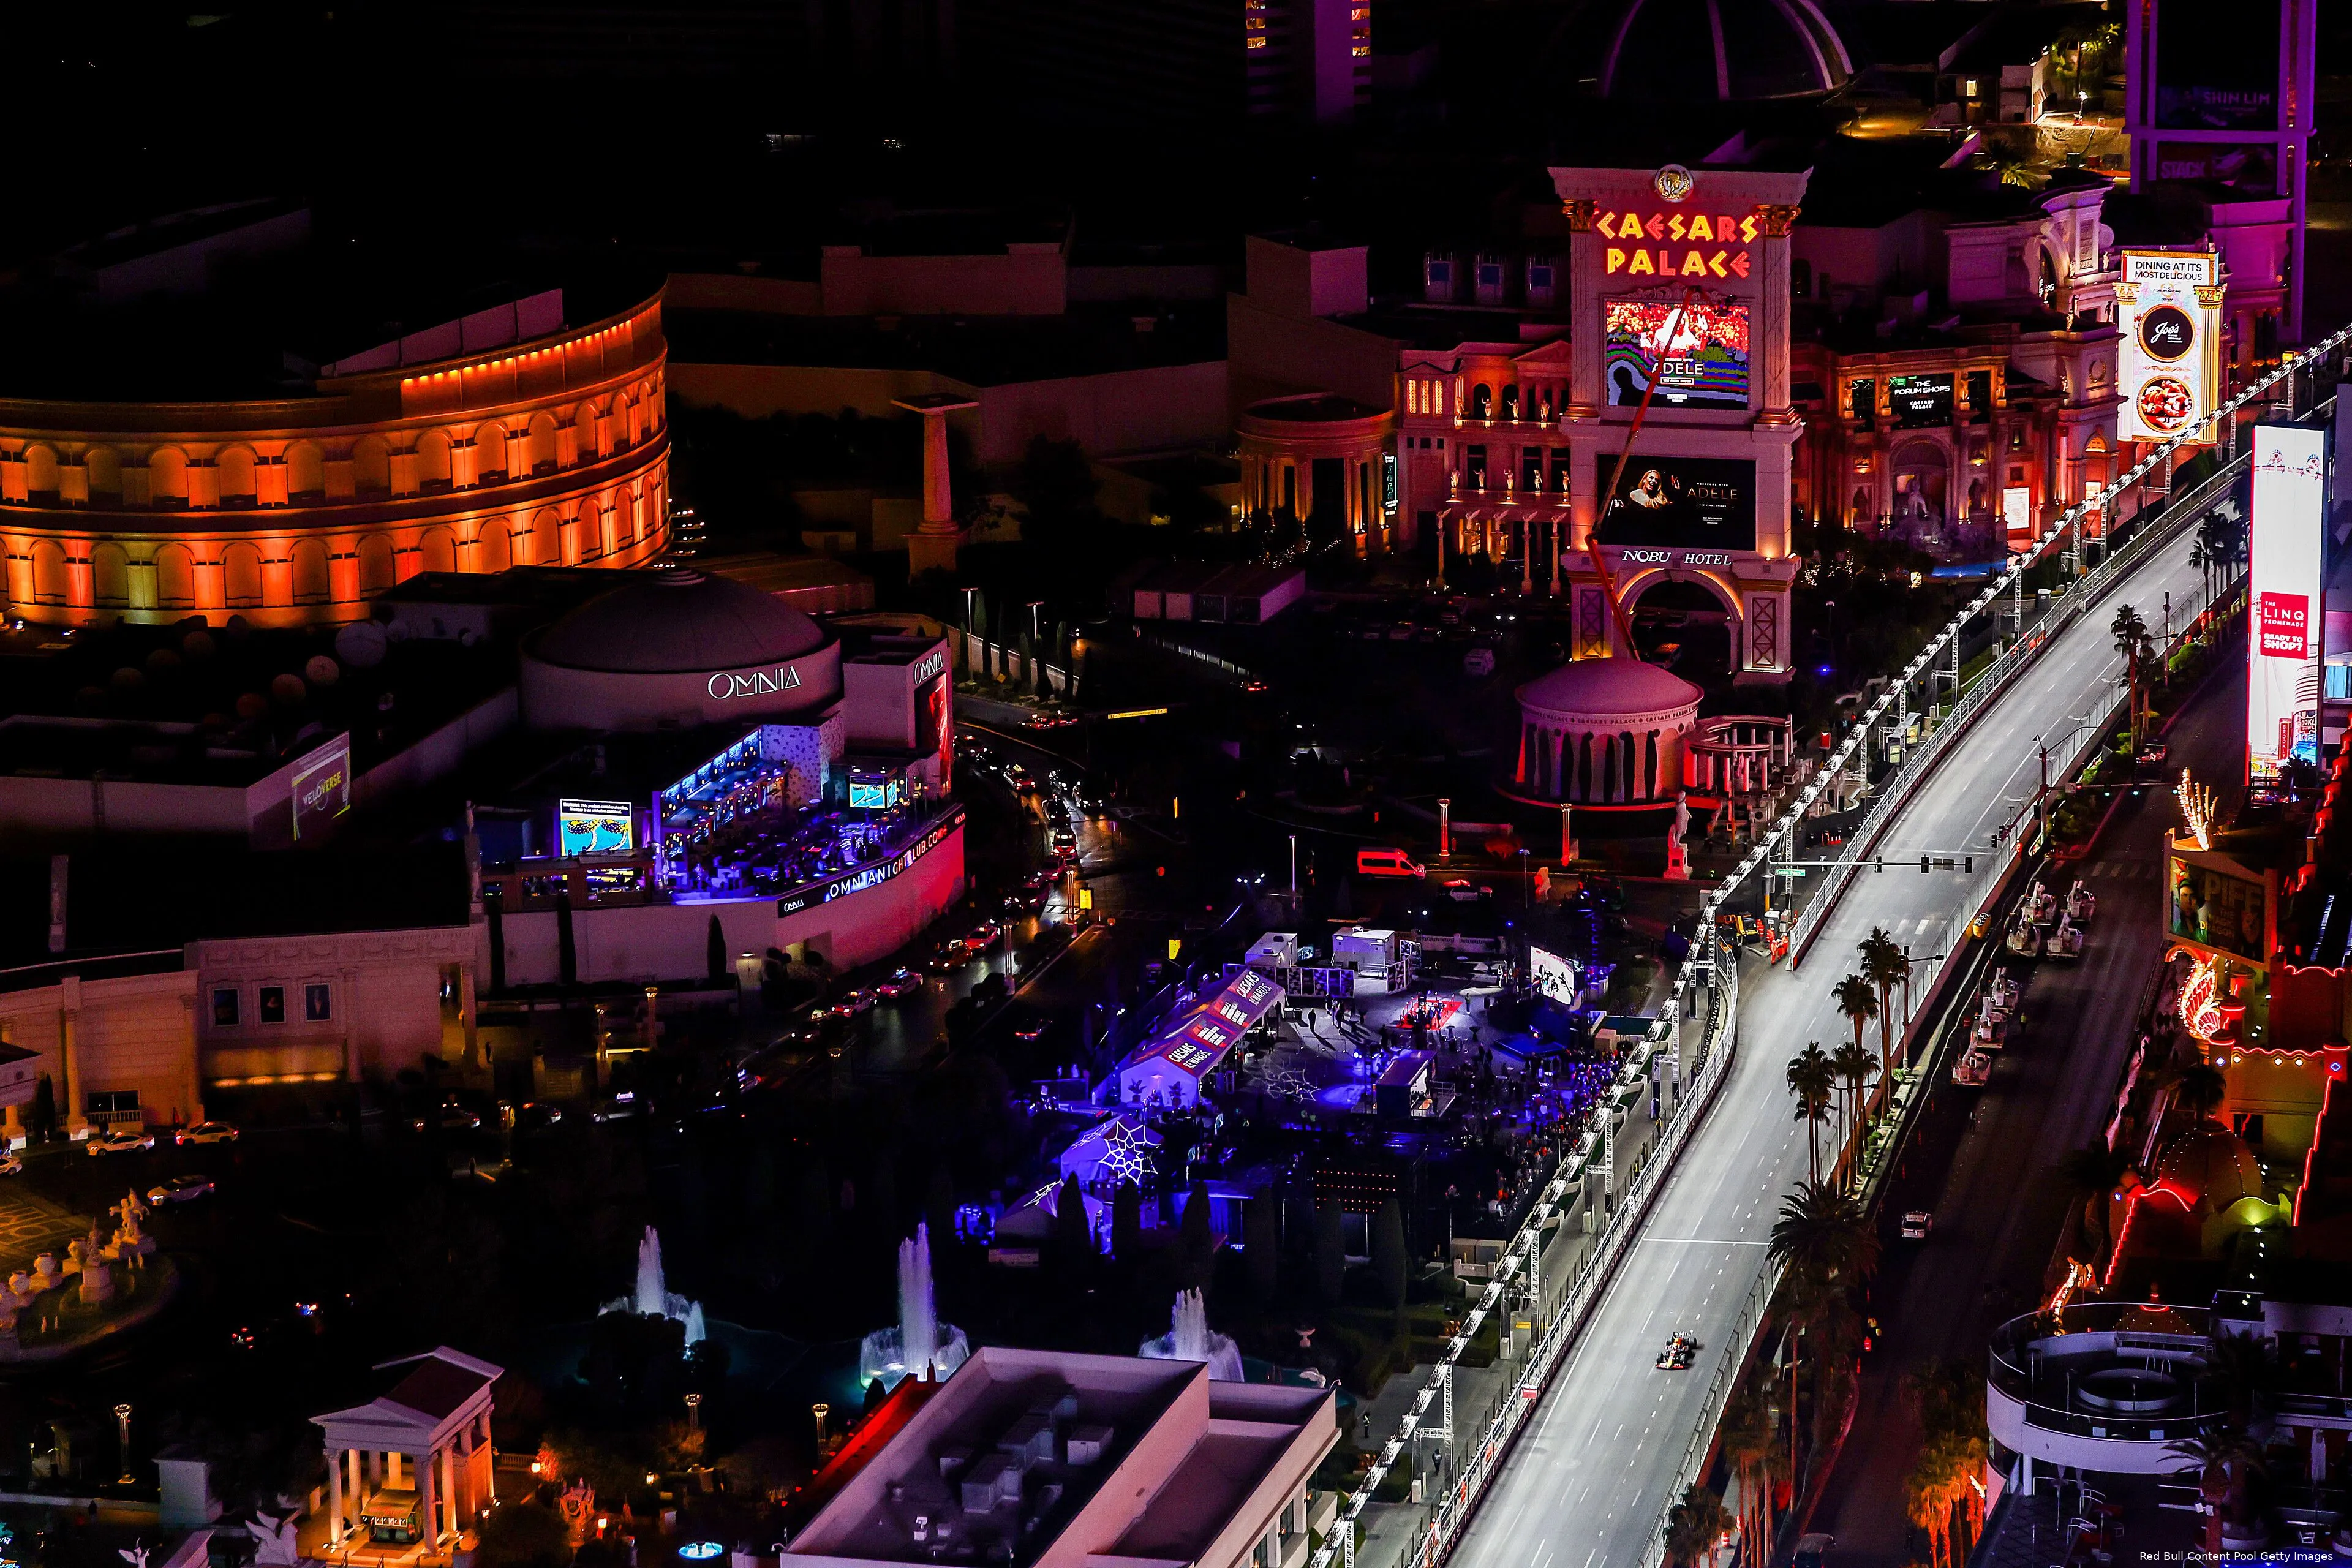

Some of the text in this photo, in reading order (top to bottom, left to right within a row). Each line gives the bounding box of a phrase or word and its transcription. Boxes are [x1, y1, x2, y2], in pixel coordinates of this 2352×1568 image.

[2203, 91, 2271, 105] SHIN LIM
[1596, 211, 1758, 244] CAESARS
[1607, 248, 1751, 279] PALACE
[2136, 261, 2171, 270] DINING
[2150, 322, 2180, 343] Joe's
[1687, 488, 1738, 500] ADELE
[1622, 550, 1671, 562] NOBU
[1684, 553, 1732, 565] HOTEL
[2264, 608, 2304, 620] LINQ
[2264, 639, 2303, 652] SHOP?
[914, 651, 944, 685] OMNIA
[707, 666, 801, 699] OMNIA
[303, 771, 342, 806] VELOVERSE
[1889, 788, 1912, 820] CAESARS
[829, 825, 948, 897] OMNIANIGHTLUB.CO
[1830, 870, 1853, 907] CAESARS
[1235, 971, 1260, 998] CAESARS
[1249, 982, 1271, 1006] REWARDS
[1168, 1042, 1197, 1063] CAESARS
[1183, 1050, 1212, 1069] REWARDS
[1670, 1120, 1695, 1166] CAESARS
[1599, 1238, 1627, 1291] CAESARS
